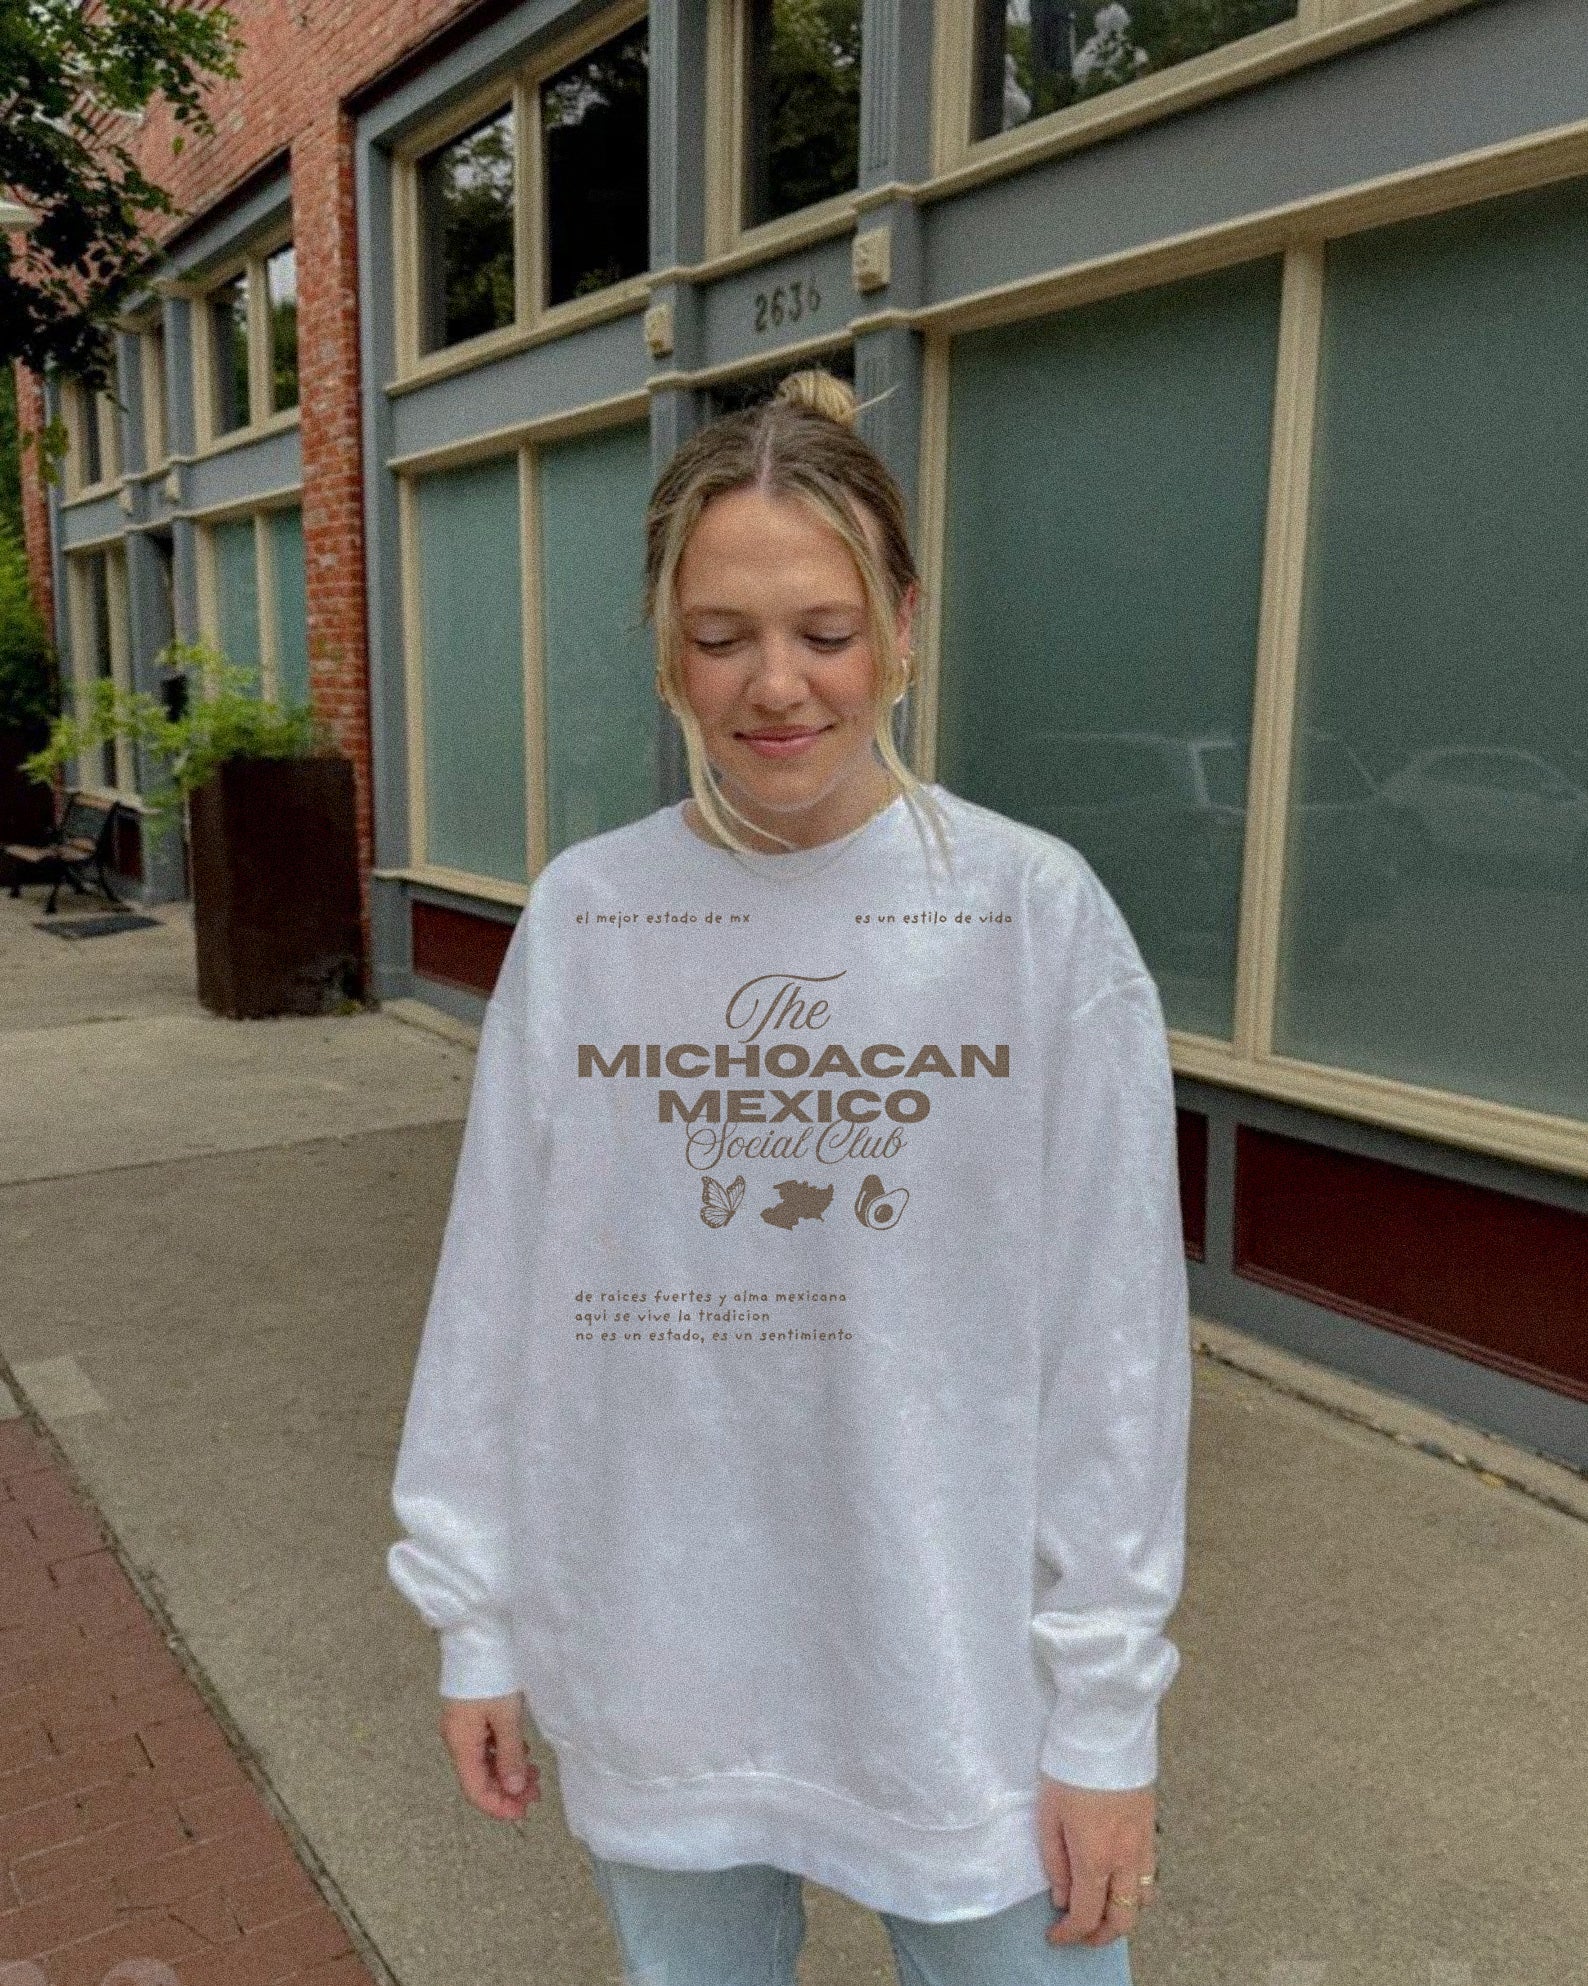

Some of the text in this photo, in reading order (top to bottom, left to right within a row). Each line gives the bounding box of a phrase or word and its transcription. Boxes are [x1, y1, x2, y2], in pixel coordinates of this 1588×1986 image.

[754, 278, 822, 334] 2636
[575, 911, 750, 929] el mejor estado de mx
[854, 910, 1013, 925] es un estilo de vida
[725, 969, 848, 1044] The
[577, 1043, 1011, 1079] MICHOACAN
[657, 1089, 932, 1124] MEXICO
[685, 1114, 908, 1171] Social Club
[574, 1289, 847, 1307] de raices fuertes y alma mexicana
[574, 1309, 770, 1327] aqui se vive la tradicion
[575, 1328, 853, 1344] no es un estado, es un sentimiento
